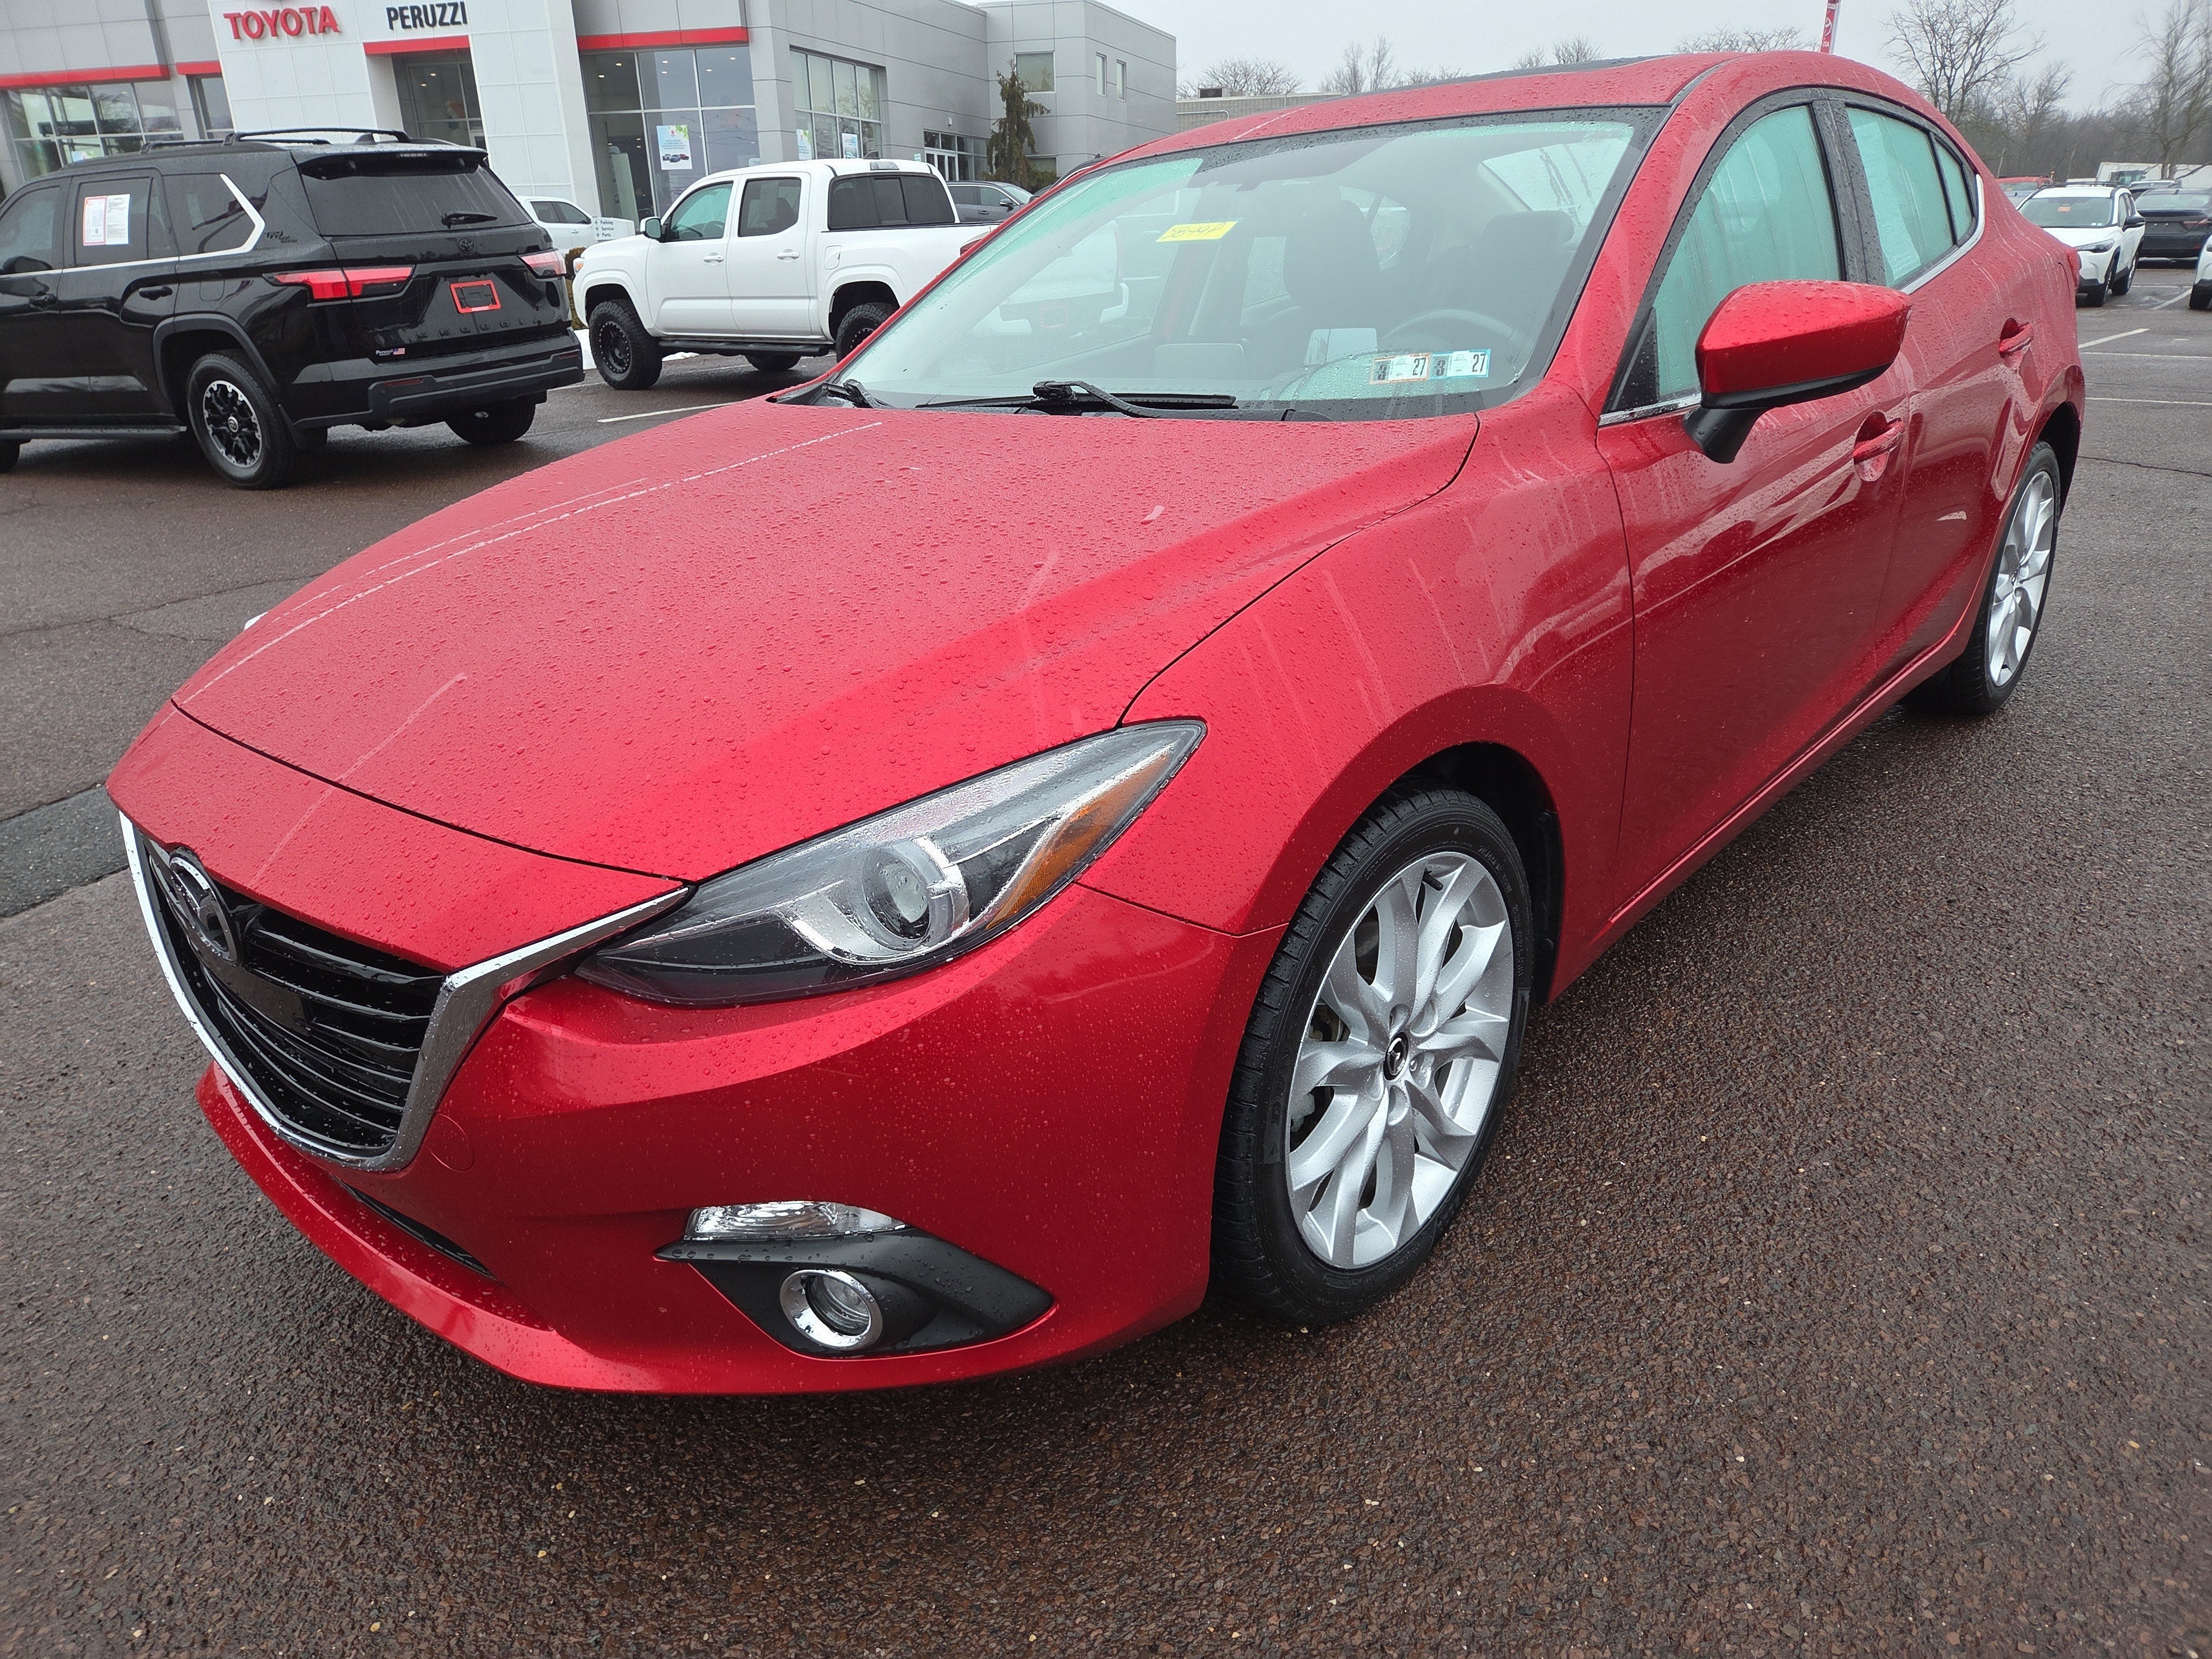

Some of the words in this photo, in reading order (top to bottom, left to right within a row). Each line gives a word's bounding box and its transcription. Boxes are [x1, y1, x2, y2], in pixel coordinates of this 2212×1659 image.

[223, 5, 340, 40] TOYOTA
[386, 1, 468, 30] PERUZZI
[1412, 357, 1426, 376] 27
[1436, 359, 1446, 376] 3
[1471, 353, 1486, 373] 27
